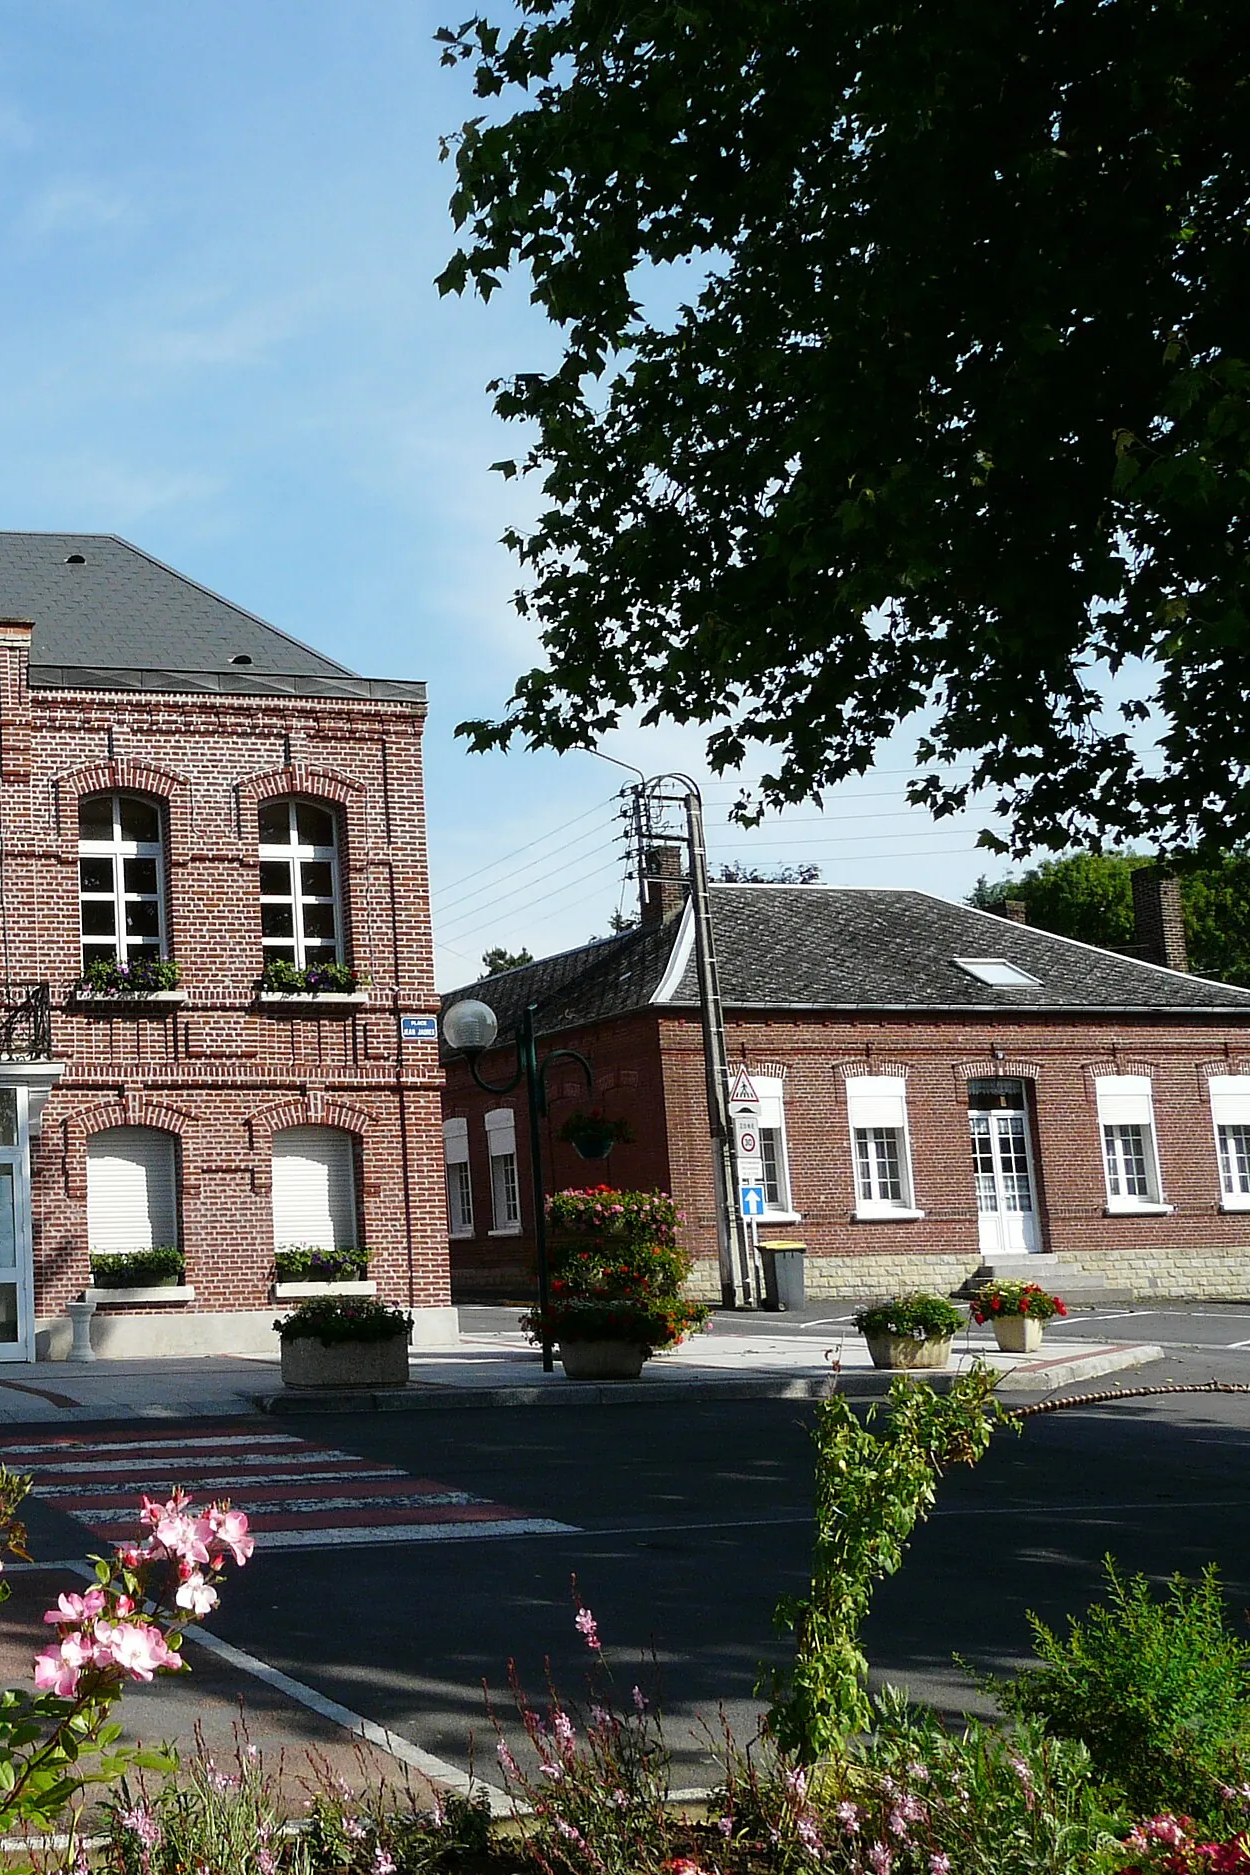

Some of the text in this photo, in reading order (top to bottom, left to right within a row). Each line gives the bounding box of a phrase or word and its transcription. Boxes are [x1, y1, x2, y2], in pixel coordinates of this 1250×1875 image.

[404, 1028, 416, 1036] JEAN
[739, 1122, 755, 1130] ZONE
[744, 1138, 752, 1147] 30
